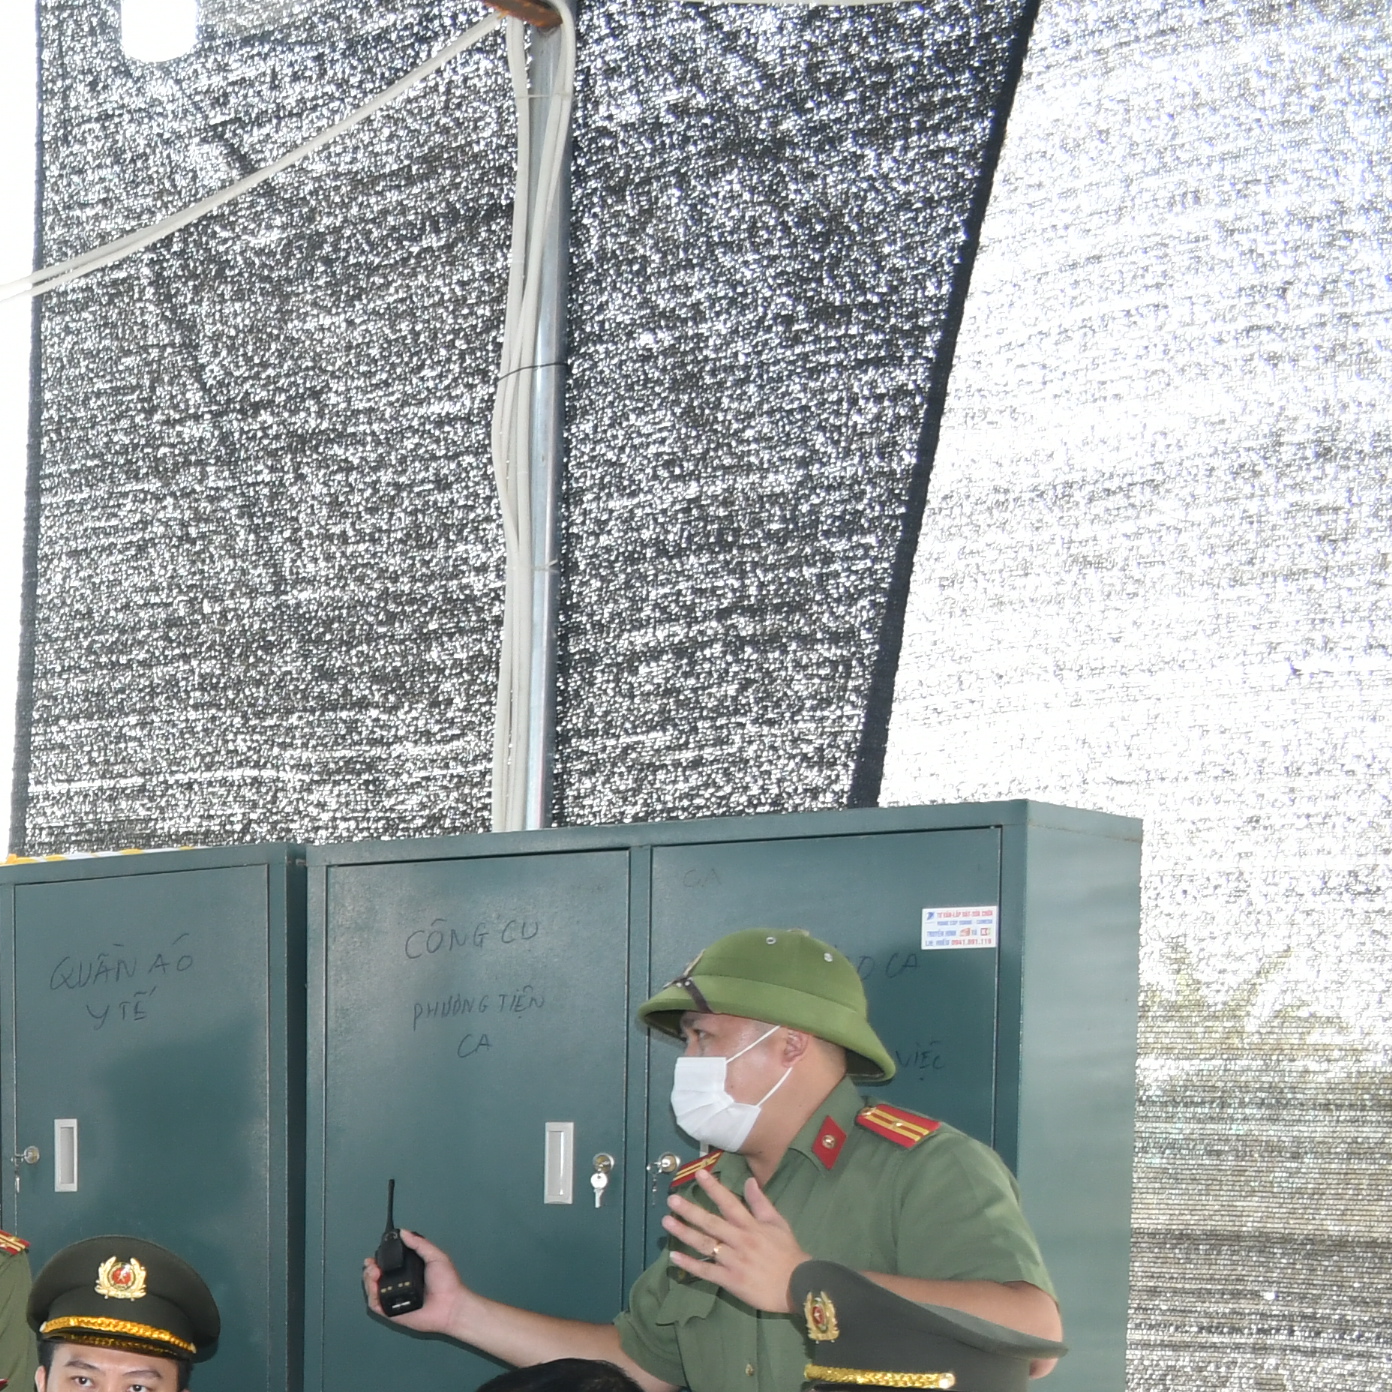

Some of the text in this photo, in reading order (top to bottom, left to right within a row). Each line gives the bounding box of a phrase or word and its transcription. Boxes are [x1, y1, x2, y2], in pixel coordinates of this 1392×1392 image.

[405, 919, 539, 960] CÔNG CỤ
[457, 1033, 491, 1058] CA
